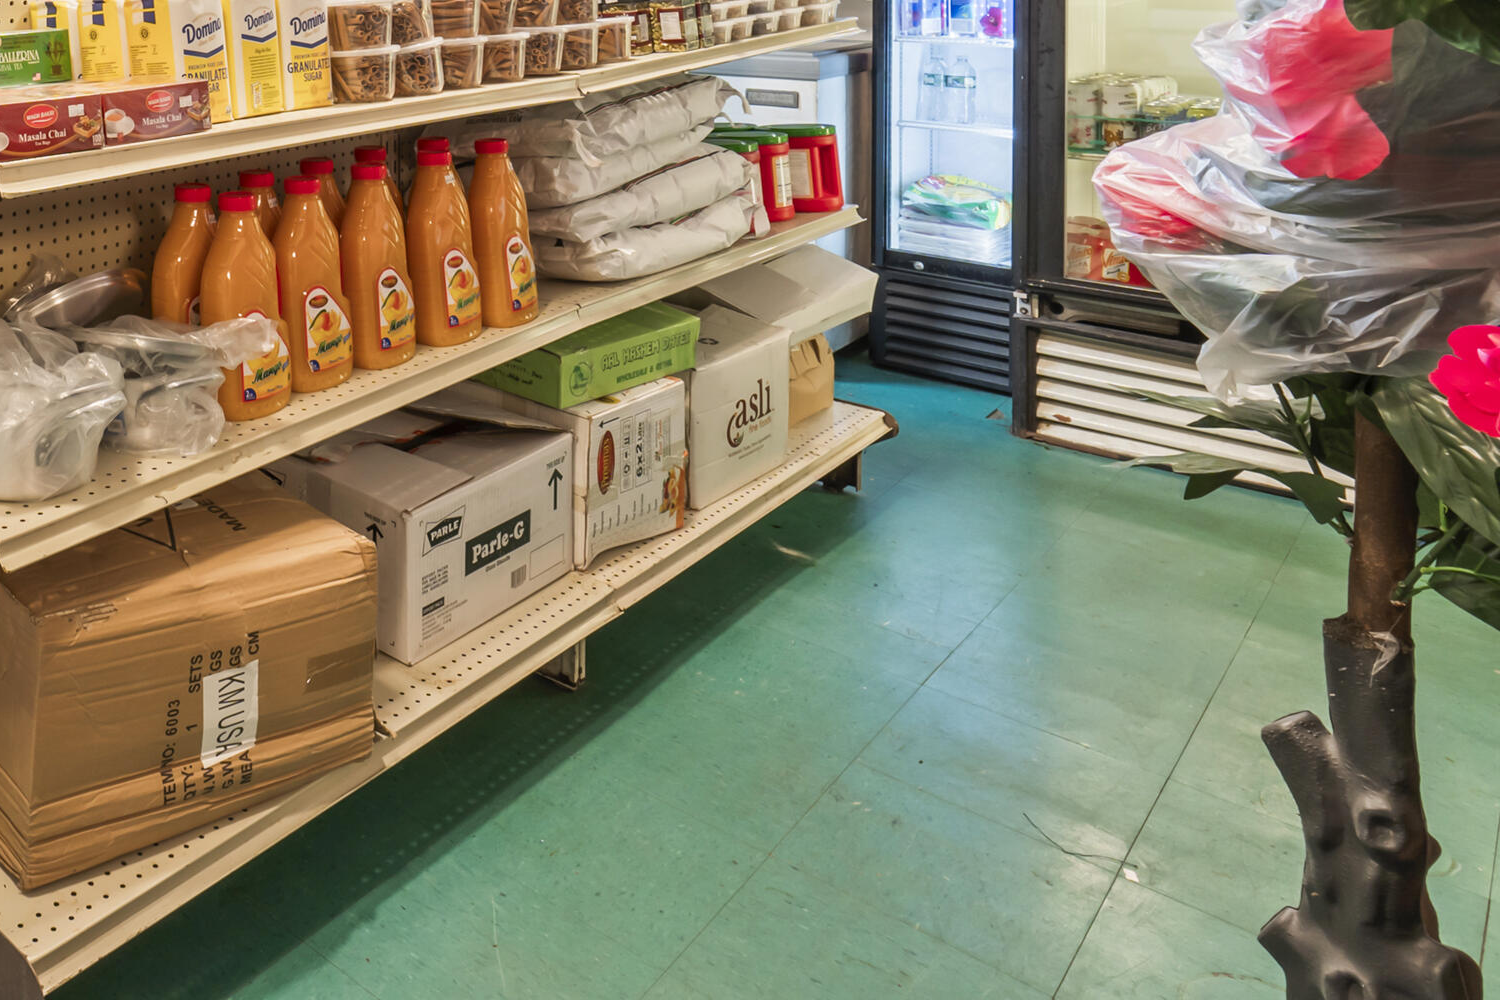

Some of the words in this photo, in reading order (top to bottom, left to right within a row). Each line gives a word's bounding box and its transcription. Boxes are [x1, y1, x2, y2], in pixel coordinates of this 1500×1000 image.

[182, 16, 222, 44] Domino
[244, 10, 274, 30] Domino
[290, 11, 326, 35] Domino
[303, 71, 322, 82] SUGAR
[142, 115, 165, 126] Masala
[166, 112, 182, 122] Chai
[18, 131, 46, 143] Masala
[48, 127, 67, 139] Chai
[316, 334, 342, 356] Mango
[252, 362, 282, 384] Mango
[616, 367, 647, 384] WHOLESALE
[198, 499, 247, 532] MADE
[430, 519, 460, 542] PARLE
[471, 520, 525, 564] Parle-G
[247, 630, 259, 656] CM
[189, 654, 203, 694] SETS
[218, 672, 245, 711] KM
[165, 699, 180, 737] 6003
[186, 723, 198, 731] 1
[216, 717, 243, 758] USA
